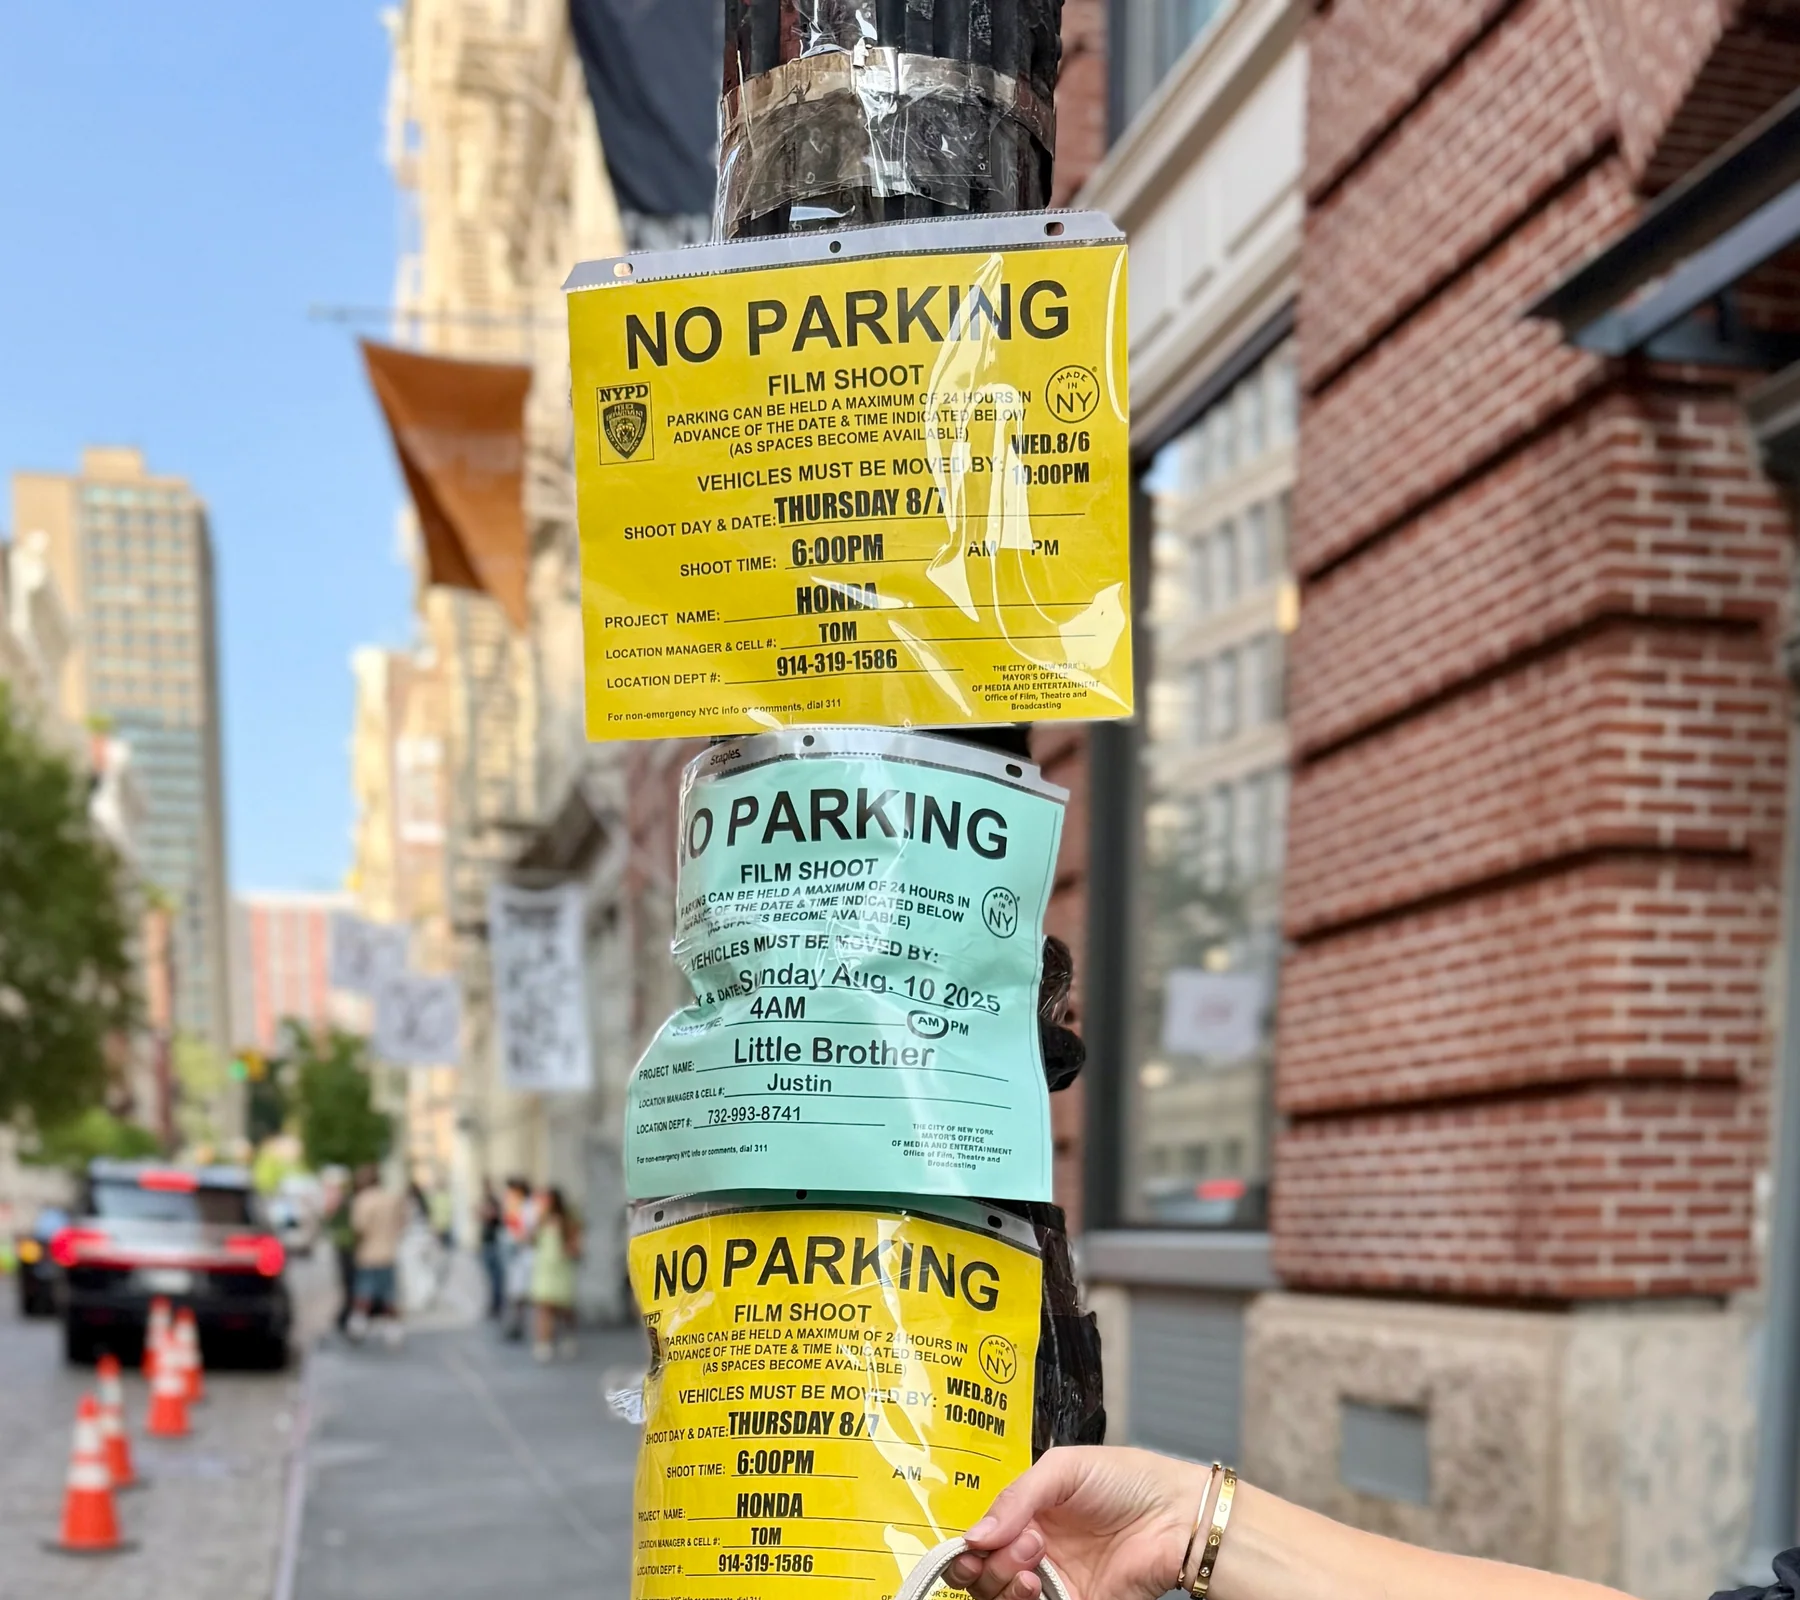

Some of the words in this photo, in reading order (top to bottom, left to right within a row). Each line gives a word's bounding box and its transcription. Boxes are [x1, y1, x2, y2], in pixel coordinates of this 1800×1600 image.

[625, 308, 723, 370] NO
[748, 280, 1069, 356] PARKING
[768, 371, 825, 396] FILM
[835, 364, 924, 390] SHOOT
[1057, 371, 1088, 383] MADE
[599, 385, 648, 402] NYPD
[1057, 392, 1093, 413] NY
[667, 410, 729, 427] PARKING
[734, 407, 763, 420] CAN
[767, 404, 785, 416] BE
[790, 400, 827, 414] HELD
[847, 394, 915, 409] MAXIMUM
[963, 392, 1013, 404] HOURS
[674, 426, 740, 444] ADVANCE
[745, 423, 763, 436] OF
[767, 420, 795, 434] THE
[799, 417, 836, 430] DATE
[854, 413, 888, 426] TIME
[892, 410, 969, 424] INDICATED
[974, 410, 1026, 421] BELOW
[730, 442, 752, 458] (AS
[757, 436, 813, 452] SPACES
[817, 428, 879, 447] BECOME
[883, 428, 969, 442] AVAILABLE)
[1012, 431, 1090, 455] WED.8/6
[698, 467, 791, 492] VEHICLES
[798, 460, 851, 482] MUST
[860, 461, 885, 476] BE
[893, 457, 964, 475] MOVED
[1012, 462, 1090, 485] 10:00PM
[624, 524, 676, 540] SHOOT
[681, 520, 712, 536] DAY
[717, 519, 727, 531] &
[732, 514, 776, 530] DATE:
[774, 488, 901, 525] THURSDAY
[906, 488, 946, 515] 8/7
[680, 560, 732, 576] SHOOT
[737, 556, 776, 572] TIME:
[791, 533, 884, 567] 6:00PM
[1032, 540, 1059, 555] PM
[605, 614, 668, 628] PROJECT
[676, 610, 720, 624] NAME:
[796, 582, 878, 615] HONDA
[606, 648, 662, 659] LOCATION
[665, 643, 722, 656] MANAGER
[735, 640, 763, 651] CELL
[819, 621, 857, 643] TOM
[607, 675, 671, 688] LOCATION
[674, 673, 706, 685] DEPT
[777, 649, 898, 677] 914-319-1586
[985, 684, 1011, 692] MEDIA
[1032, 681, 1100, 690] ENTERTAINMENT
[1020, 693, 1038, 701] Film,
[608, 713, 623, 721] For
[626, 708, 696, 720] non-emergency
[699, 706, 719, 716] NYC
[722, 706, 739, 715] info
[807, 700, 823, 710] dial
[826, 699, 841, 708] 311
[1012, 702, 1061, 710] Broadcasting
[726, 787, 1008, 860] PARKING
[741, 863, 791, 883] FILM
[799, 858, 878, 880] SHOOT
[708, 892, 734, 902] CAN
[738, 890, 754, 899] BE
[757, 888, 790, 899] HELD
[805, 882, 865, 895] MAXIMUM
[909, 884, 954, 904] HOURS
[993, 892, 1013, 906] MADE
[761, 901, 793, 911] DATE
[917, 903, 964, 923] BELOW
[989, 908, 1013, 931] NY
[691, 940, 749, 970] VEHICLES
[754, 935, 800, 952] MUST
[740, 963, 825, 992] Sunday
[832, 963, 893, 993] Aug.
[904, 976, 935, 1000] 10
[944, 983, 1000, 1012] 2025
[751, 996, 805, 1019] 4AM
[951, 1021, 969, 1036] PM
[639, 1065, 669, 1080] PROJECT
[673, 1061, 695, 1074] NAME:
[734, 1037, 801, 1064] Little
[812, 1037, 935, 1067] Brother
[639, 1097, 665, 1108] LOCATION
[667, 1092, 694, 1104] MANAGER
[767, 1074, 832, 1092] Justin
[637, 1121, 668, 1134] LOCATION
[669, 1119, 685, 1130] DEPT
[708, 1106, 801, 1125] 732-993-8741
[740, 1145, 753, 1153] dial
[755, 1144, 768, 1152] 311
[904, 1141, 929, 1149] MEDIA
[950, 1143, 1012, 1155] ENTERTAINMENT
[958, 1135, 984, 1143] OFFICE
[654, 1244, 707, 1300] NO
[723, 1235, 1000, 1311] PARKING
[734, 1304, 782, 1323] FILM
[789, 1303, 872, 1323] SHOOT
[707, 1331, 729, 1342] CAN
[732, 1330, 745, 1340] BE
[749, 1329, 781, 1340] HELD
[796, 1328, 859, 1341] MAXIMUM
[863, 1331, 882, 1342] OF
[905, 1334, 952, 1350] HOURS
[956, 1342, 968, 1354] IN
[988, 1340, 1011, 1352] MADE
[667, 1347, 710, 1362] ADVANCE
[713, 1346, 727, 1356] OF
[730, 1345, 751, 1355] THE
[754, 1344, 787, 1355] DATE
[803, 1344, 832, 1354] TIME
[914, 1351, 963, 1367] BELOW
[703, 1362, 718, 1375] (AS
[721, 1360, 766, 1371] SPACES
[769, 1359, 821, 1370] BECOME
[986, 1354, 1012, 1378] NY
[679, 1386, 744, 1404] VEHICLES
[749, 1385, 796, 1400] MUST
[801, 1385, 825, 1399] BE
[947, 1377, 1008, 1411] WED.8/6
[646, 1431, 667, 1445] SHOOT
[669, 1429, 685, 1442] DAY
[698, 1426, 729, 1438] DATE:
[729, 1411, 835, 1435] THURSDAY
[839, 1412, 879, 1437] 8/7
[944, 1404, 1005, 1437] 10:00PM
[667, 1466, 694, 1478] SHOOT
[699, 1464, 725, 1475] TIME:
[737, 1450, 815, 1475] 6:00PM
[892, 1465, 921, 1481] AM
[954, 1472, 980, 1489] PM
[663, 1509, 686, 1519] NAME:
[737, 1493, 803, 1518] HONDA
[658, 1539, 685, 1547] MANAGER
[694, 1538, 710, 1546] CELL
[751, 1527, 782, 1545] TOM
[660, 1565, 676, 1574] DEPT
[718, 1554, 813, 1573] 914-319-1586
